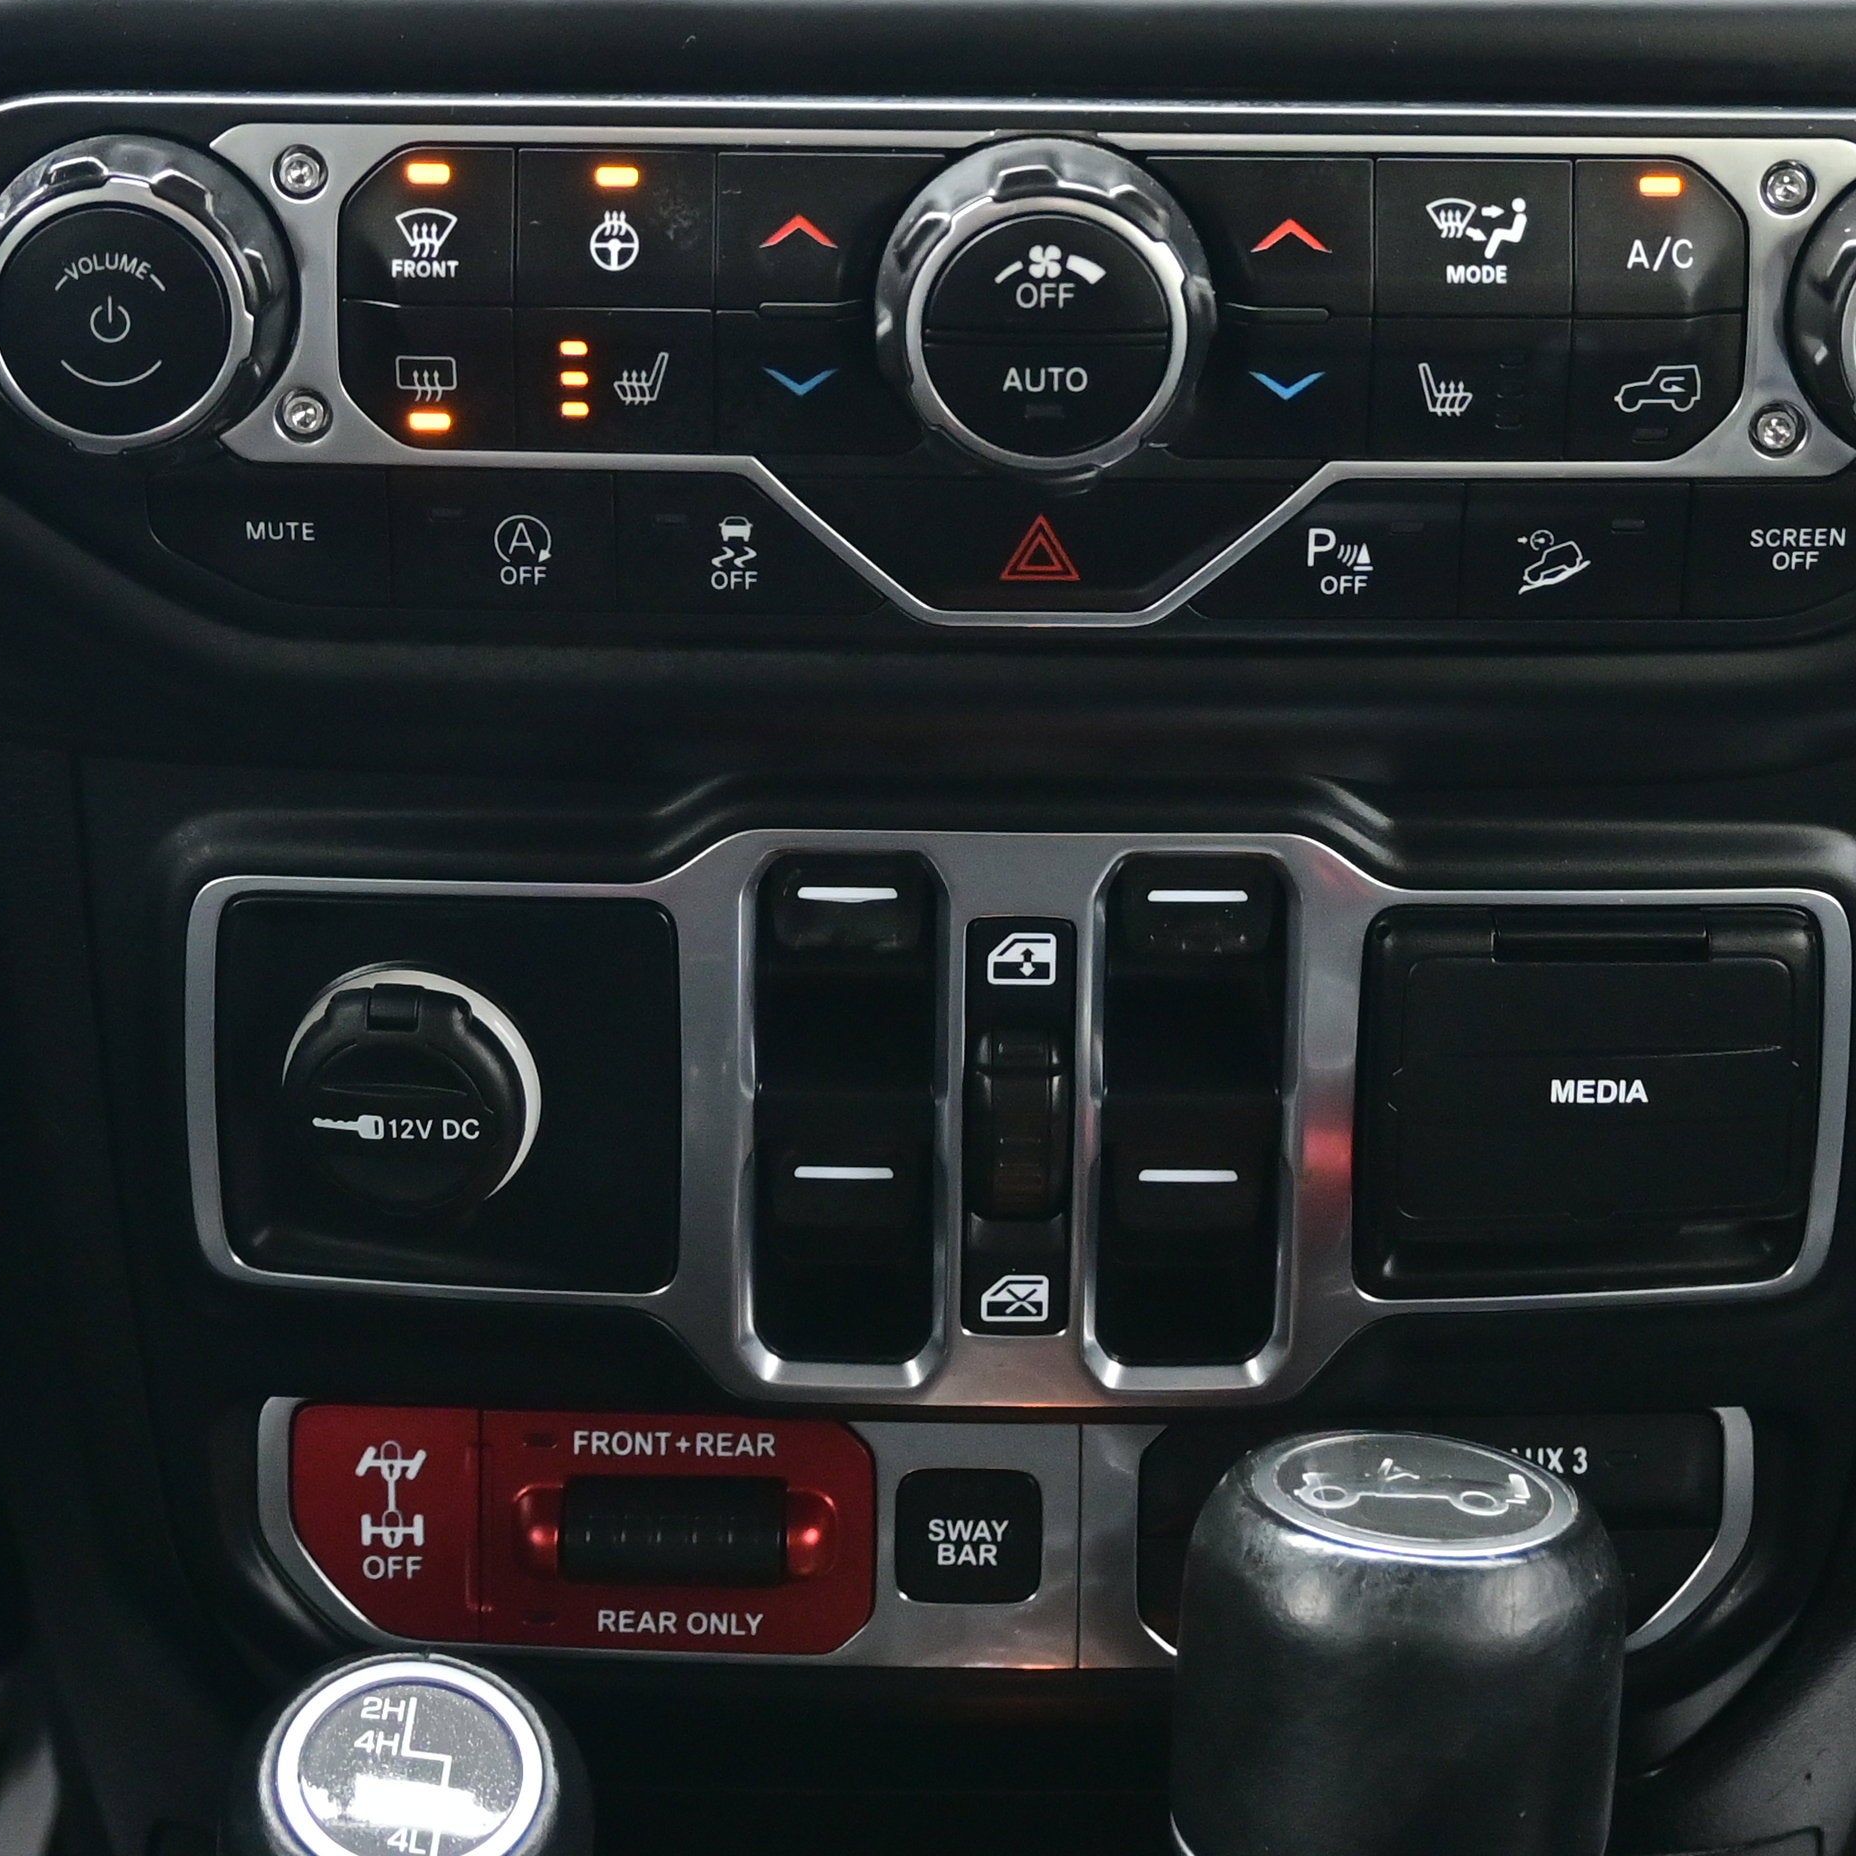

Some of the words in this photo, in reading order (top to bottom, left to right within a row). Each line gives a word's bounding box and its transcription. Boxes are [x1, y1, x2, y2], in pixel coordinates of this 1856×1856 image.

[63, 251, 152, 281] VOLUME
[1626, 236, 1694, 273] A/C
[391, 259, 459, 280] FRONT
[1446, 264, 1508, 284] MODE
[1015, 282, 1075, 309] OFF
[1002, 366, 1089, 393] AUTO
[246, 521, 315, 542] MUTE
[1749, 528, 1846, 548] SCREEN
[1772, 552, 1819, 571] OFF
[500, 566, 547, 586] OFF
[711, 571, 758, 591] OFF
[1320, 576, 1367, 595] OFF
[1550, 1080, 1649, 1104] MEDIA
[388, 1119, 433, 1139] 12V
[443, 1119, 480, 1140] DC
[573, 1431, 776, 1458] FRONT+REAR
[1572, 1446, 1588, 1475] 3
[927, 1519, 1008, 1543] SWAY
[362, 1555, 422, 1579] OFF
[937, 1544, 997, 1566] BAR
[597, 1610, 677, 1633] REAR
[686, 1613, 763, 1636] ONLY
[360, 1696, 406, 1722] 2H
[354, 1731, 400, 1757] 4H
[387, 1828, 426, 1855] 4L
